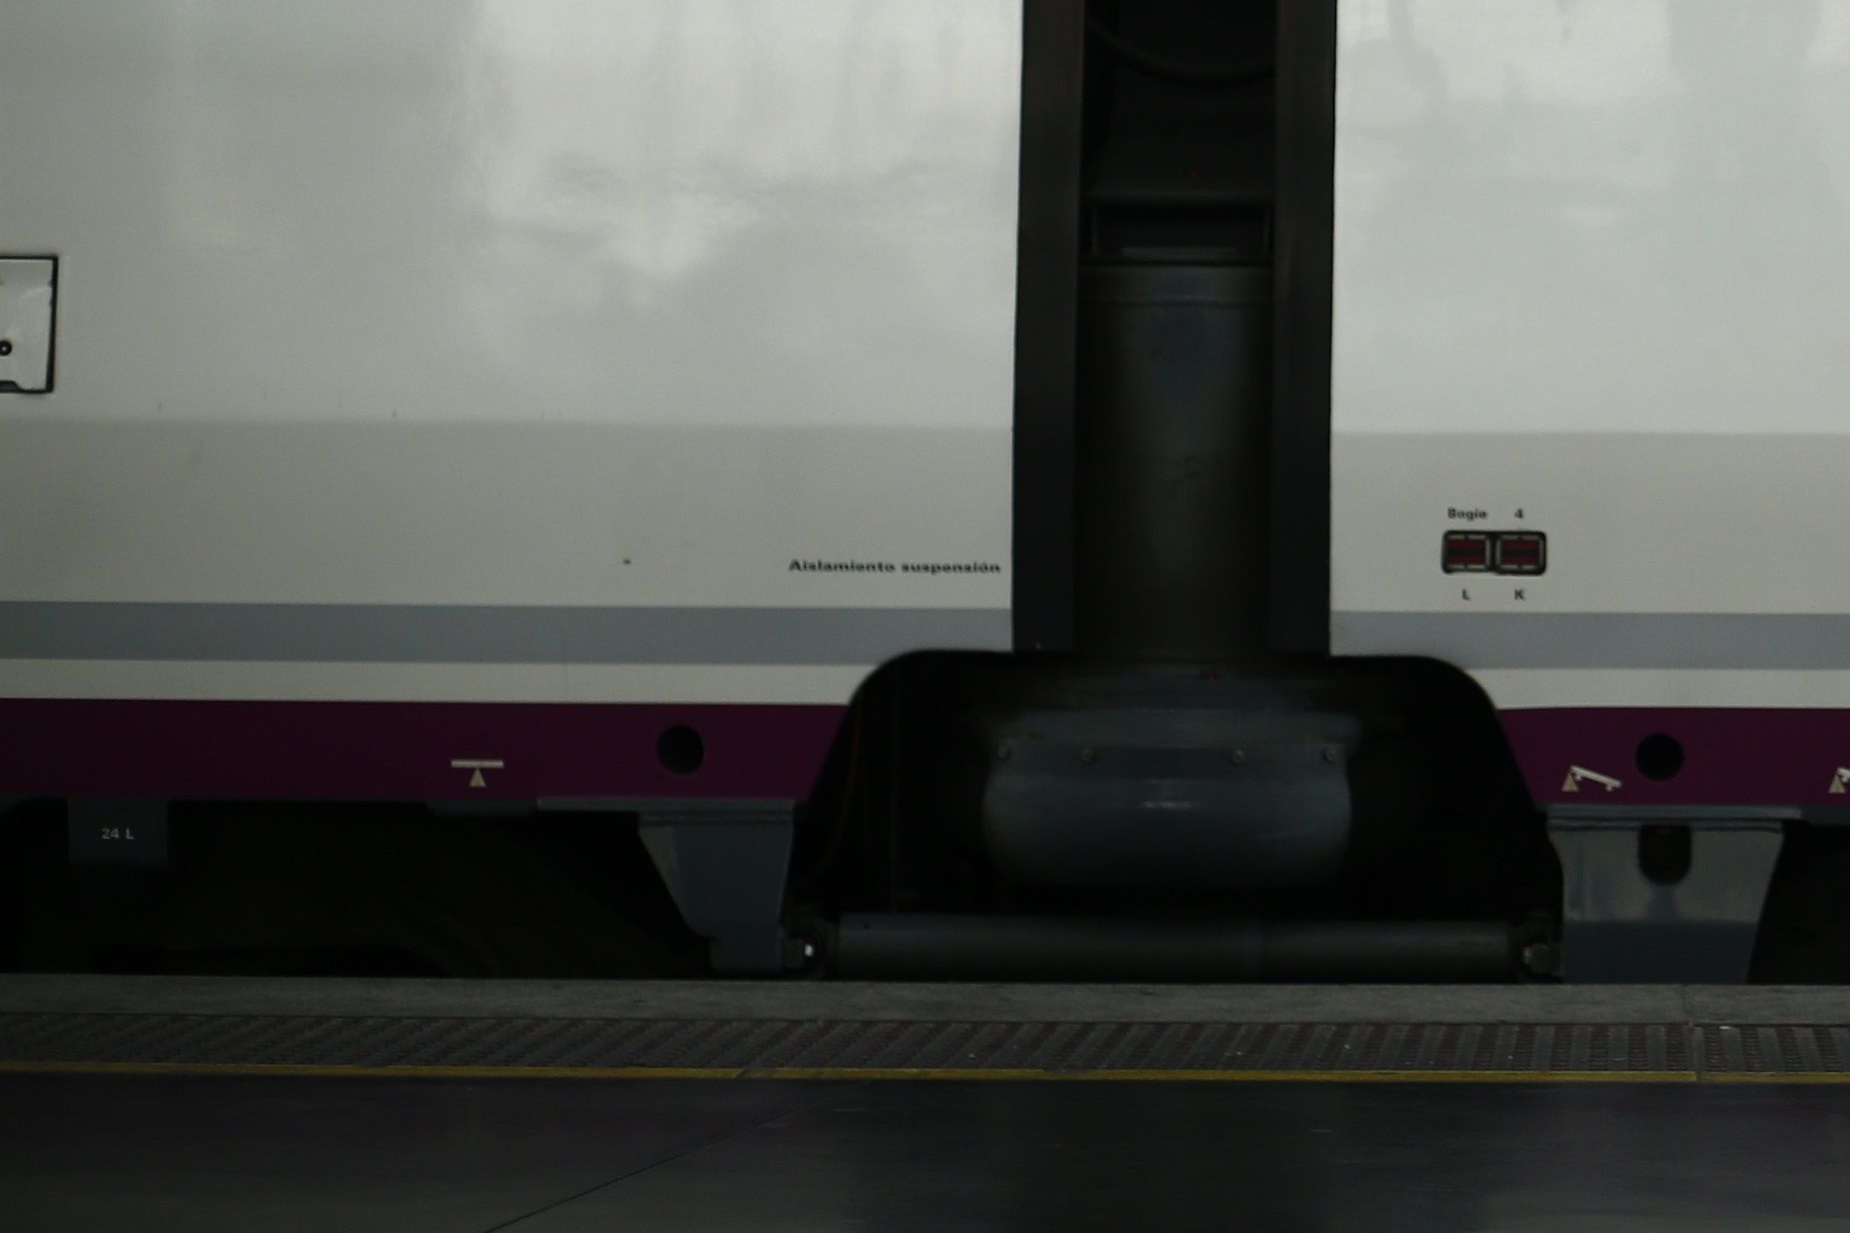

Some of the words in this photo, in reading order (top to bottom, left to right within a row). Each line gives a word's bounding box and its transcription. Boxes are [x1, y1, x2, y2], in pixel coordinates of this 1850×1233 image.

[1447, 508, 1488, 520] Bogie
[1514, 507, 1524, 519] 4
[789, 559, 896, 573] Aislamiento
[1462, 589, 1471, 600] L
[1514, 589, 1525, 600] K
[101, 827, 120, 840] 24
[125, 827, 135, 840] L
